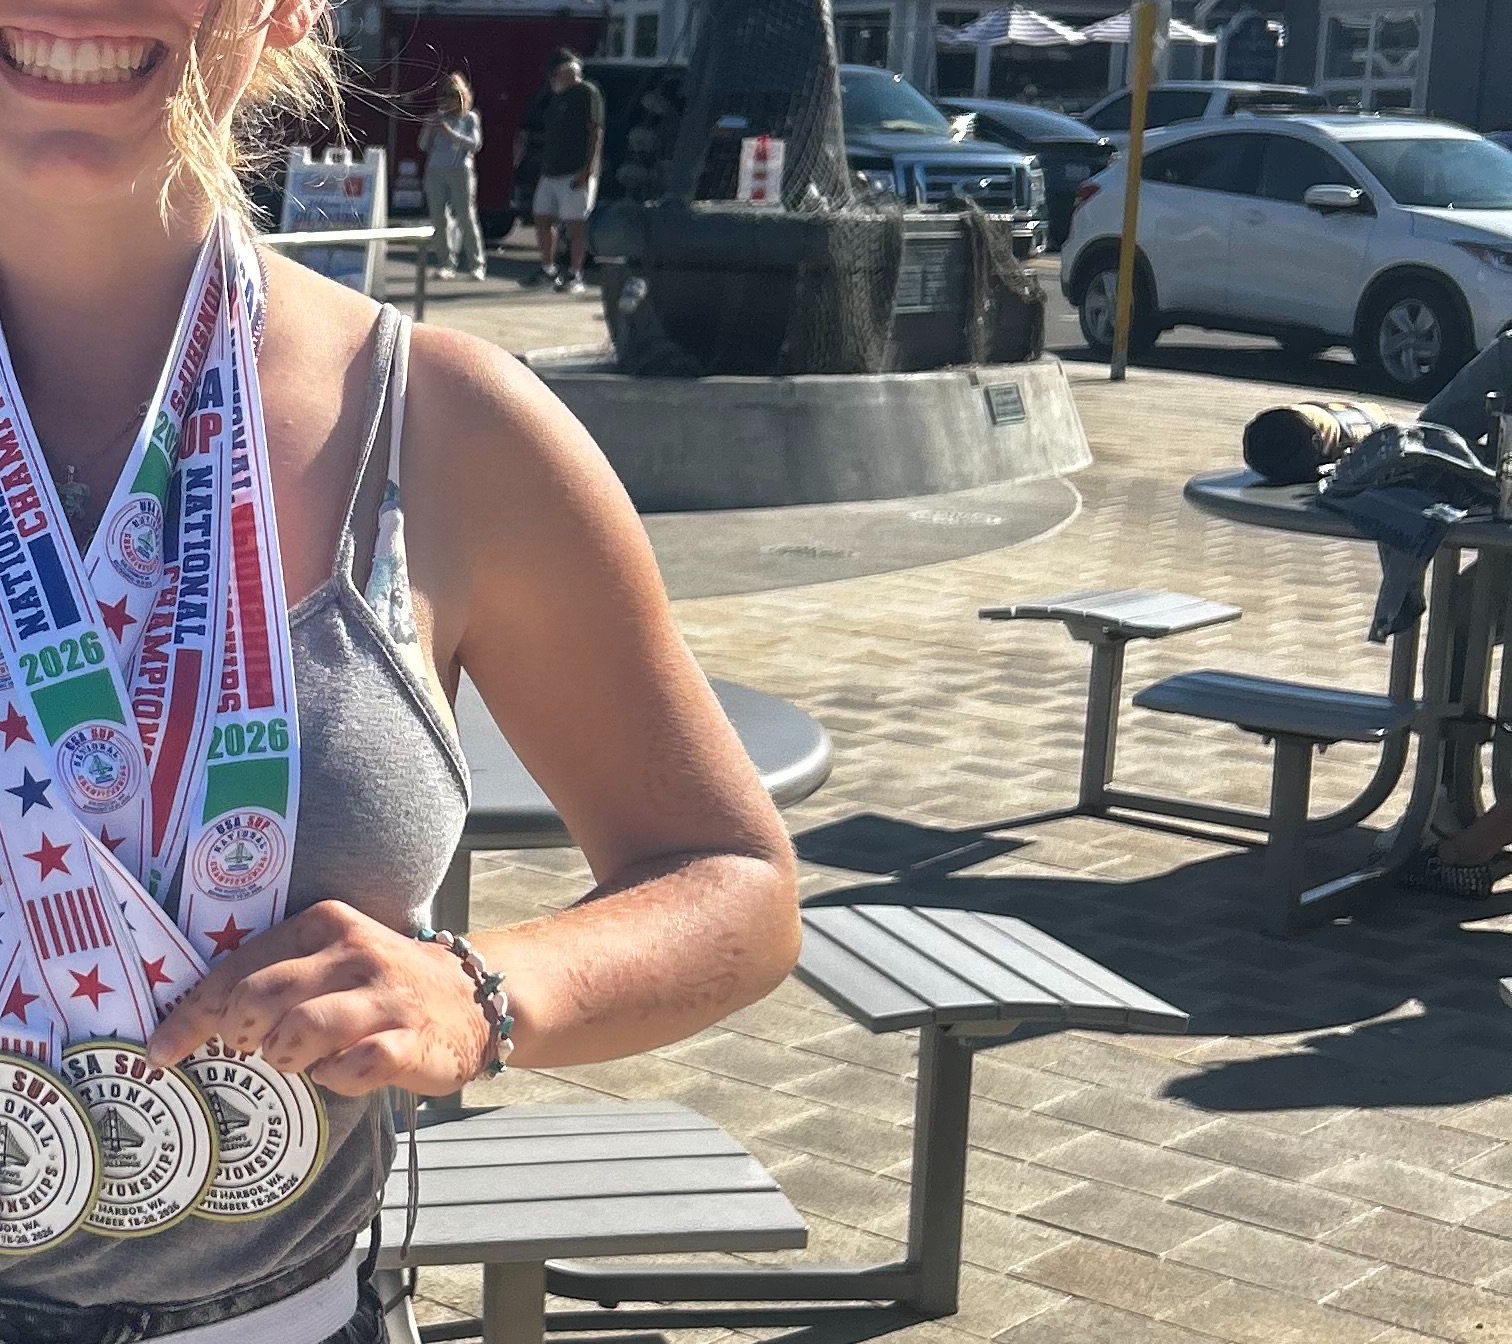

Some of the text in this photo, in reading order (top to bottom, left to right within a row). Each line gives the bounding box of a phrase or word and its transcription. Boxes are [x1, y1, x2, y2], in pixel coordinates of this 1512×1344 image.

[179, 412, 222, 460] UP
[174, 464, 213, 644] NATIONAL
[18, 630, 106, 687] 2026
[206, 717, 290, 760] 2026
[12, 1069, 60, 1107] SUP
[79, 1083, 166, 1126] TIONAL
[193, 1066, 267, 1101] IONAL
[101, 1141, 175, 1197] IONSHIPS
